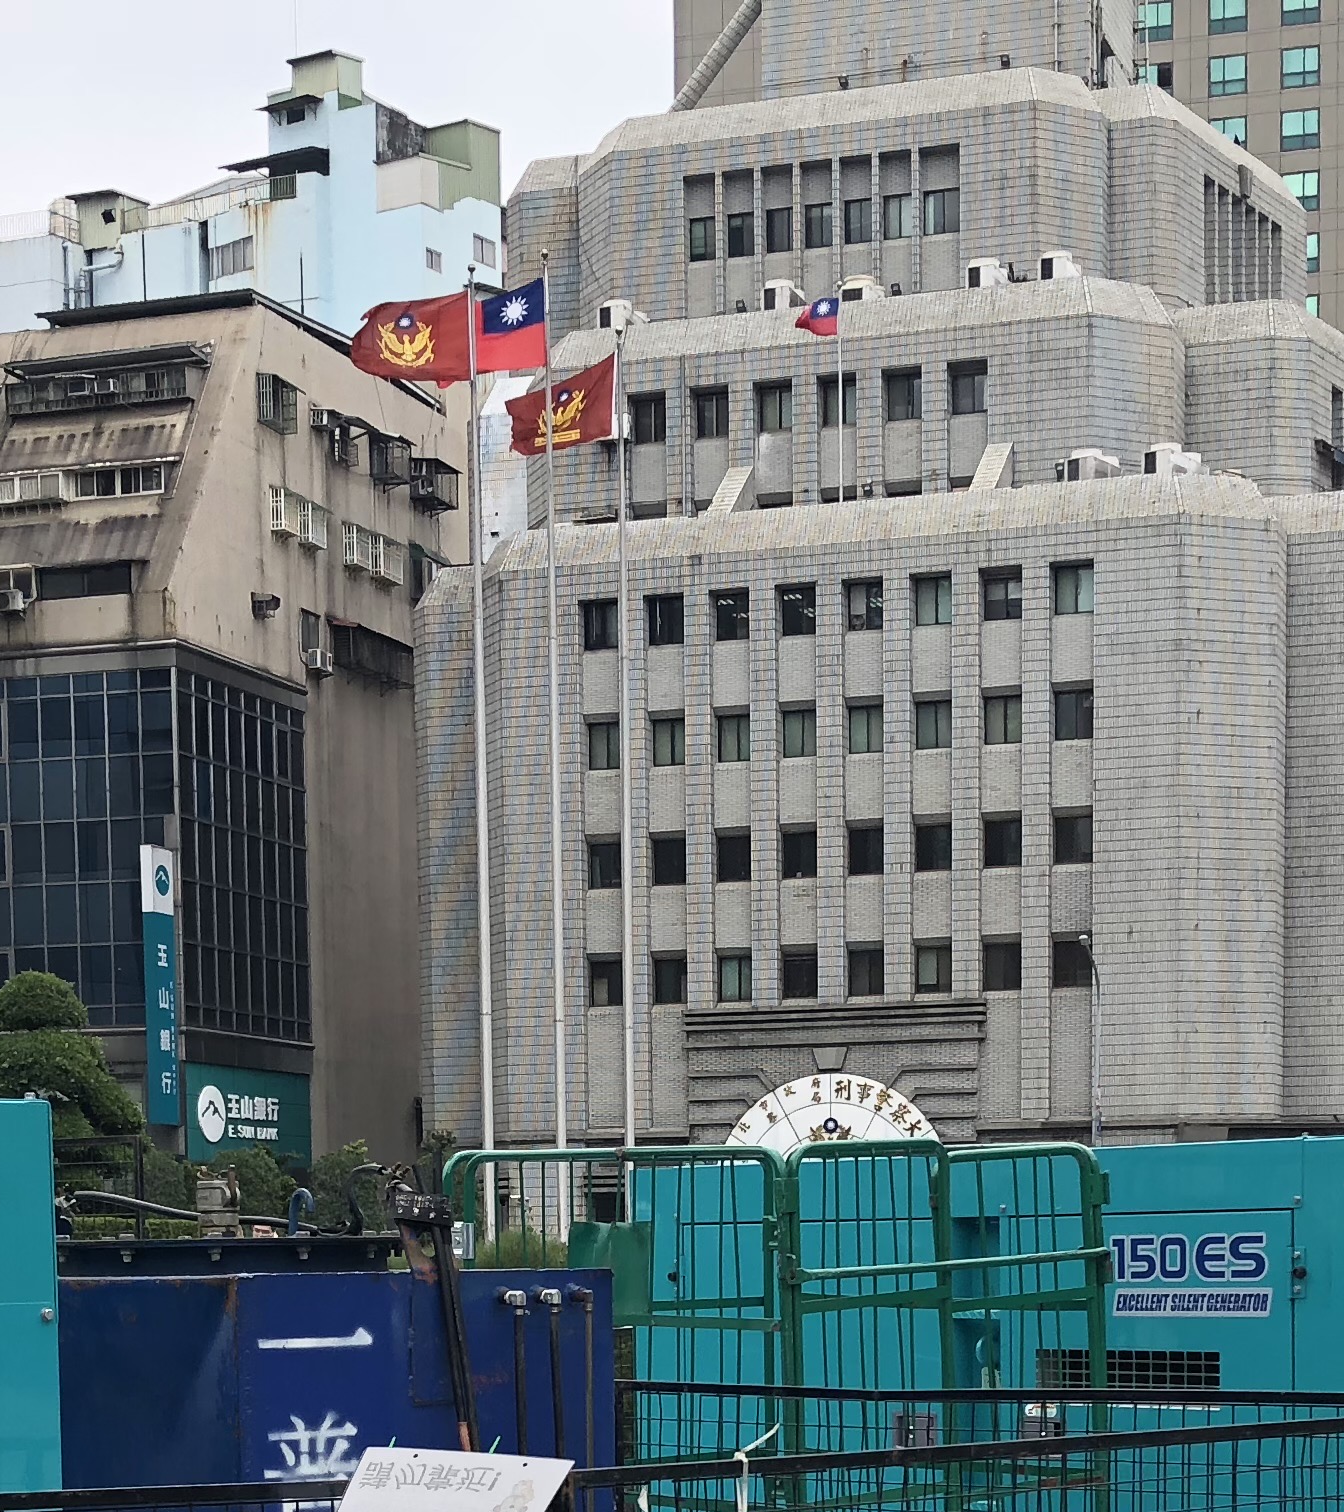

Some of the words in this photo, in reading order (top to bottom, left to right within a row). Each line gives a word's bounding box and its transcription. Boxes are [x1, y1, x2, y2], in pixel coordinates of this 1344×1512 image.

[157, 943, 172, 1095] 玉山銀行
[227, 1093, 280, 1121] 玉山銀行
[256, 1126, 279, 1140] BANK
[1116, 1293, 1170, 1312] EXCELLENT
[1170, 1293, 1207, 1312] SILENT
[1207, 1293, 1269, 1312] GENERATOR
